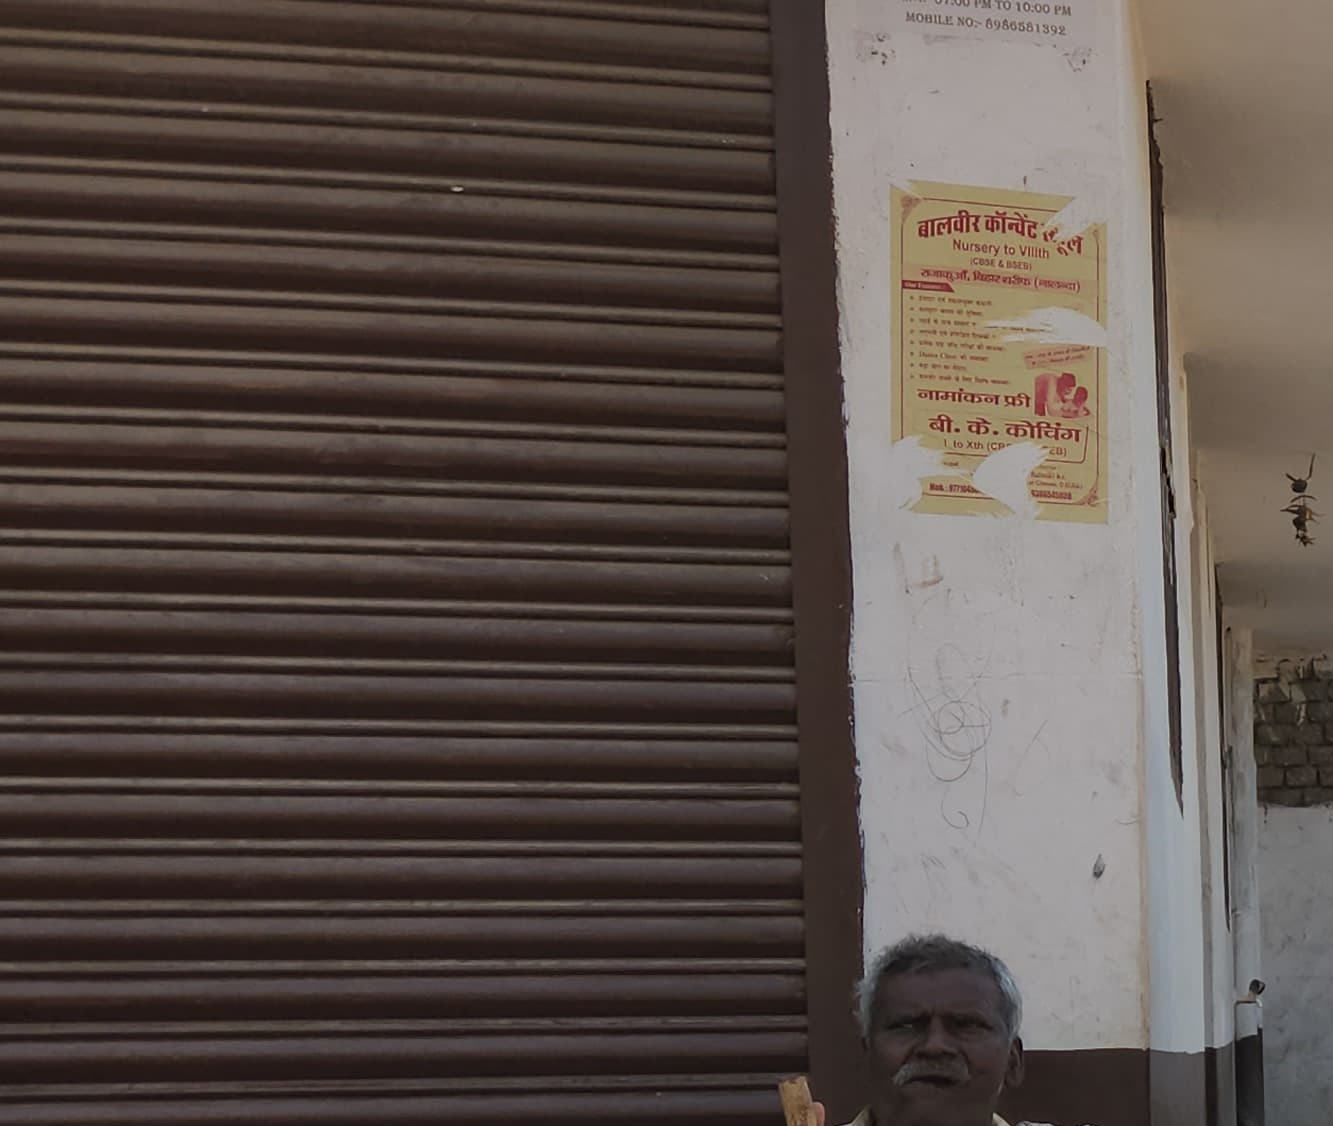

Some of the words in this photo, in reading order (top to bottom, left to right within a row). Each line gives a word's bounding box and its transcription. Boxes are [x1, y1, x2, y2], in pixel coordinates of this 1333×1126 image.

[995, 0, 1012, 10] TO
[1016, 2, 1050, 14] 10:00
[1054, 7, 1072, 17] PM
[905, 11, 954, 26] MOBILE
[917, 209, 981, 239] बालवीर
[952, 238, 1000, 258] Nursery
[1003, 243, 1016, 256] to
[998, 258, 1005, 268] &
[917, 388, 1000, 405] नामांकन
[1003, 390, 1032, 408] फ्री
[928, 414, 960, 434] बी.
[966, 417, 999, 436] के.
[1004, 420, 1082, 443] कोचिंग
[953, 439, 964, 449] to
[966, 440, 984, 451] Xth
